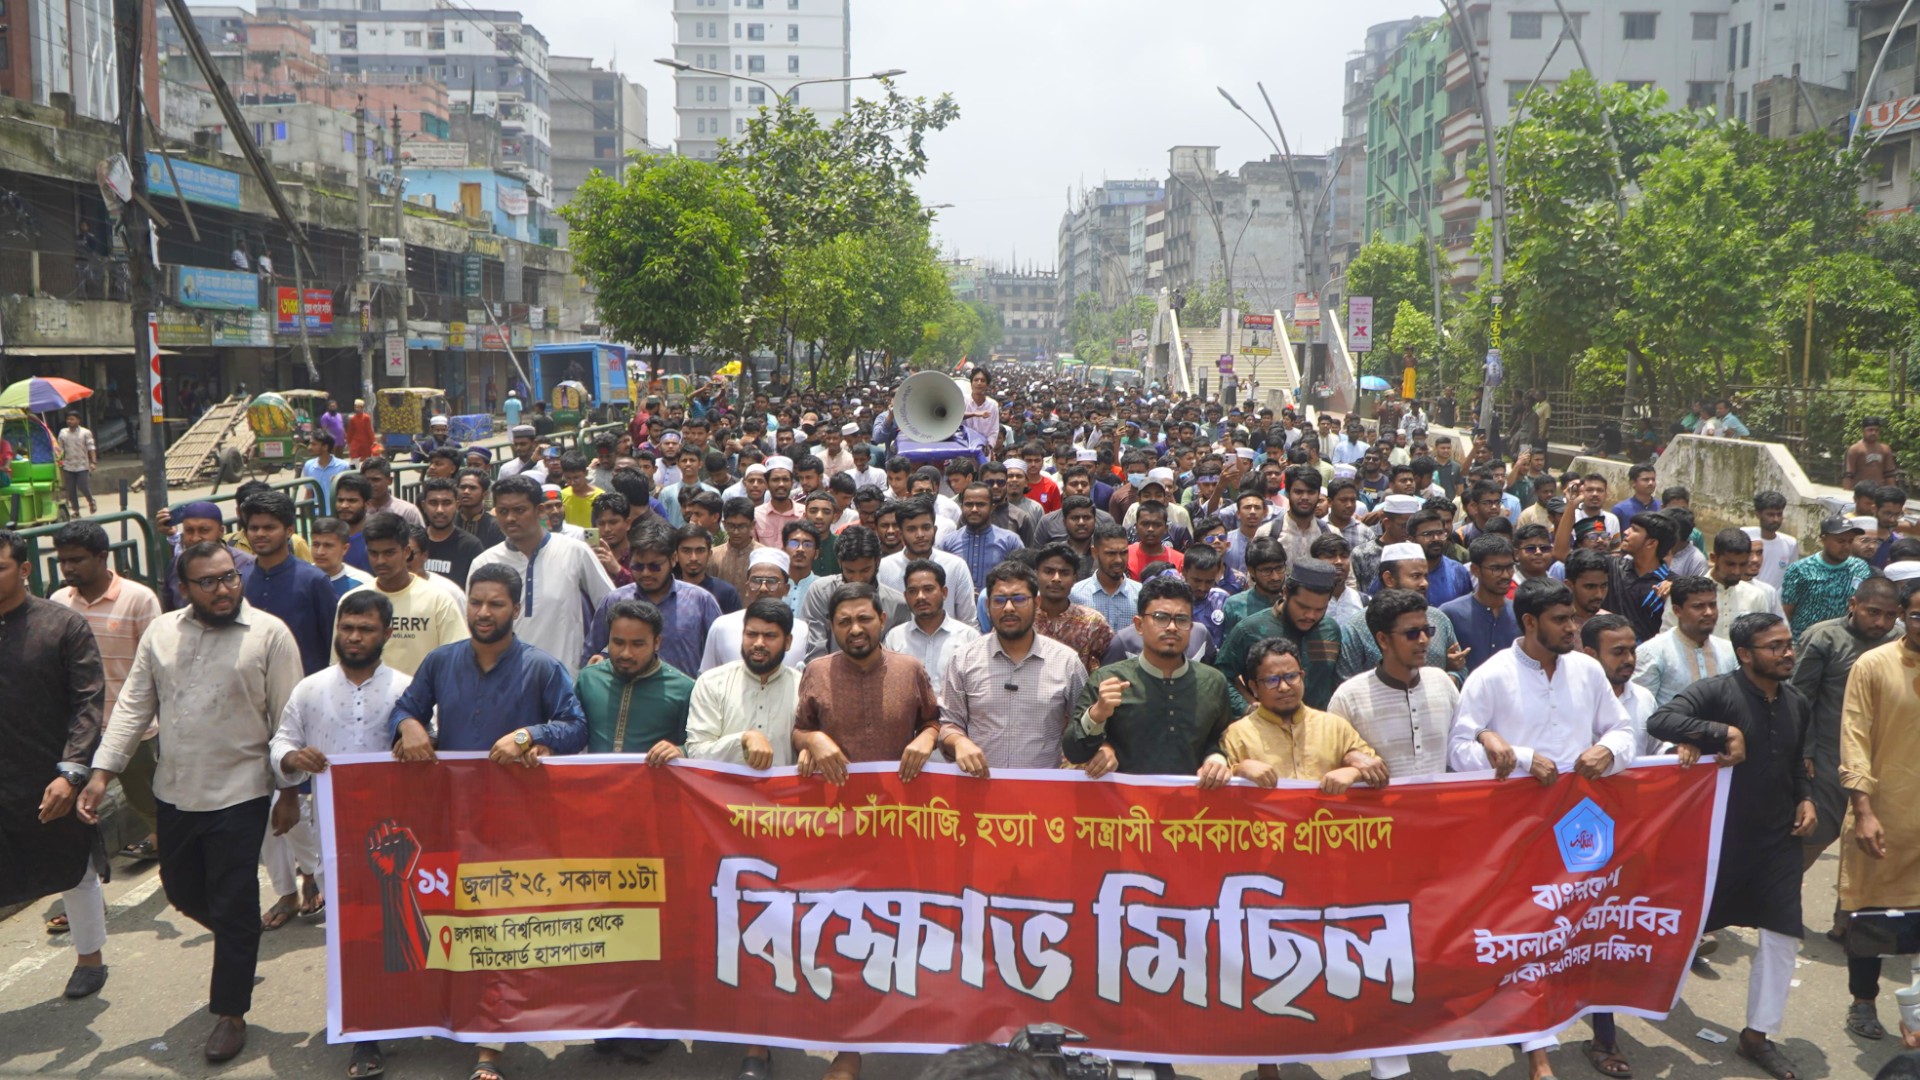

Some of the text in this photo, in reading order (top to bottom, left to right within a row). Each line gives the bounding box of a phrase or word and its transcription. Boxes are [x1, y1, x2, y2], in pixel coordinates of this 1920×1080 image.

[424, 559, 452, 574] UMA
[391, 617, 430, 632] ERRY
[727, 794, 1393, 854] সারাদেশে চাঁদাবাজি, হত্যা ও সন্ত্রাসী কর্মকাণ্ডের প্রতিবাদে
[417, 867, 450, 897] ১২
[559, 870, 612, 891] সকাল
[617, 863, 658, 892] ১১টা
[454, 913, 624, 945] জগন্নাথ বিশ্ববিদ্যালয় থেকে
[711, 856, 1416, 1022] বিক্ষোভ মিছিল
[1474, 915, 1573, 965] ইসলামী
[470, 941, 605, 969] মিটফোর্ড হাসপাতাল
[1545, 946, 1592, 976] হানগর
[1594, 934, 1653, 963] দক্ষিণ
